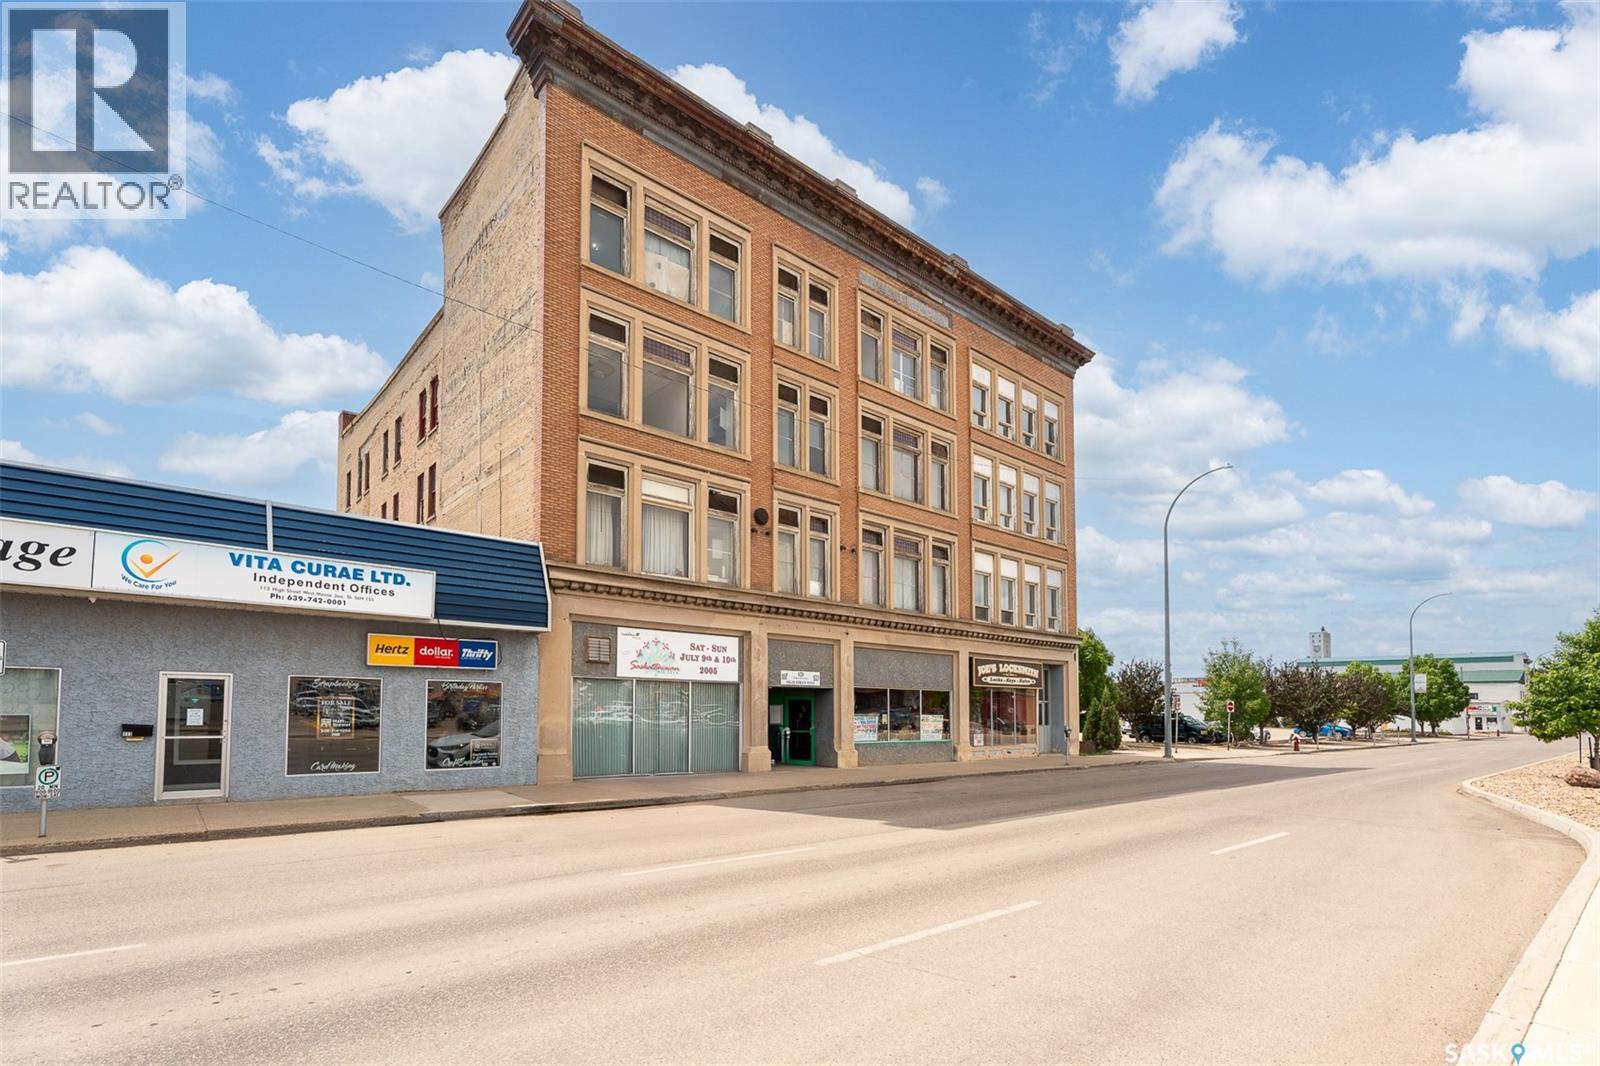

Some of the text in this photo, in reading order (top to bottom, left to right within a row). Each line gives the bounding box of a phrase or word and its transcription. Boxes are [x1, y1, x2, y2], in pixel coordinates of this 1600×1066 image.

[228, 552, 411, 587] VITA CURAE LTD.
[121, 573, 177, 590] We Care For You
[253, 573, 395, 597] Independent Offices
[287, 594, 347, 606] 639-742-0001
[375, 643, 409, 655] Hertz
[461, 648, 494, 661] Thrifty
[690, 642, 705, 652] SAT
[711, 644, 728, 653] SUN
[680, 653, 699, 662] JULY
[701, 655, 713, 663] 9th
[722, 656, 736, 664] 10th
[699, 666, 718, 675] 2005
